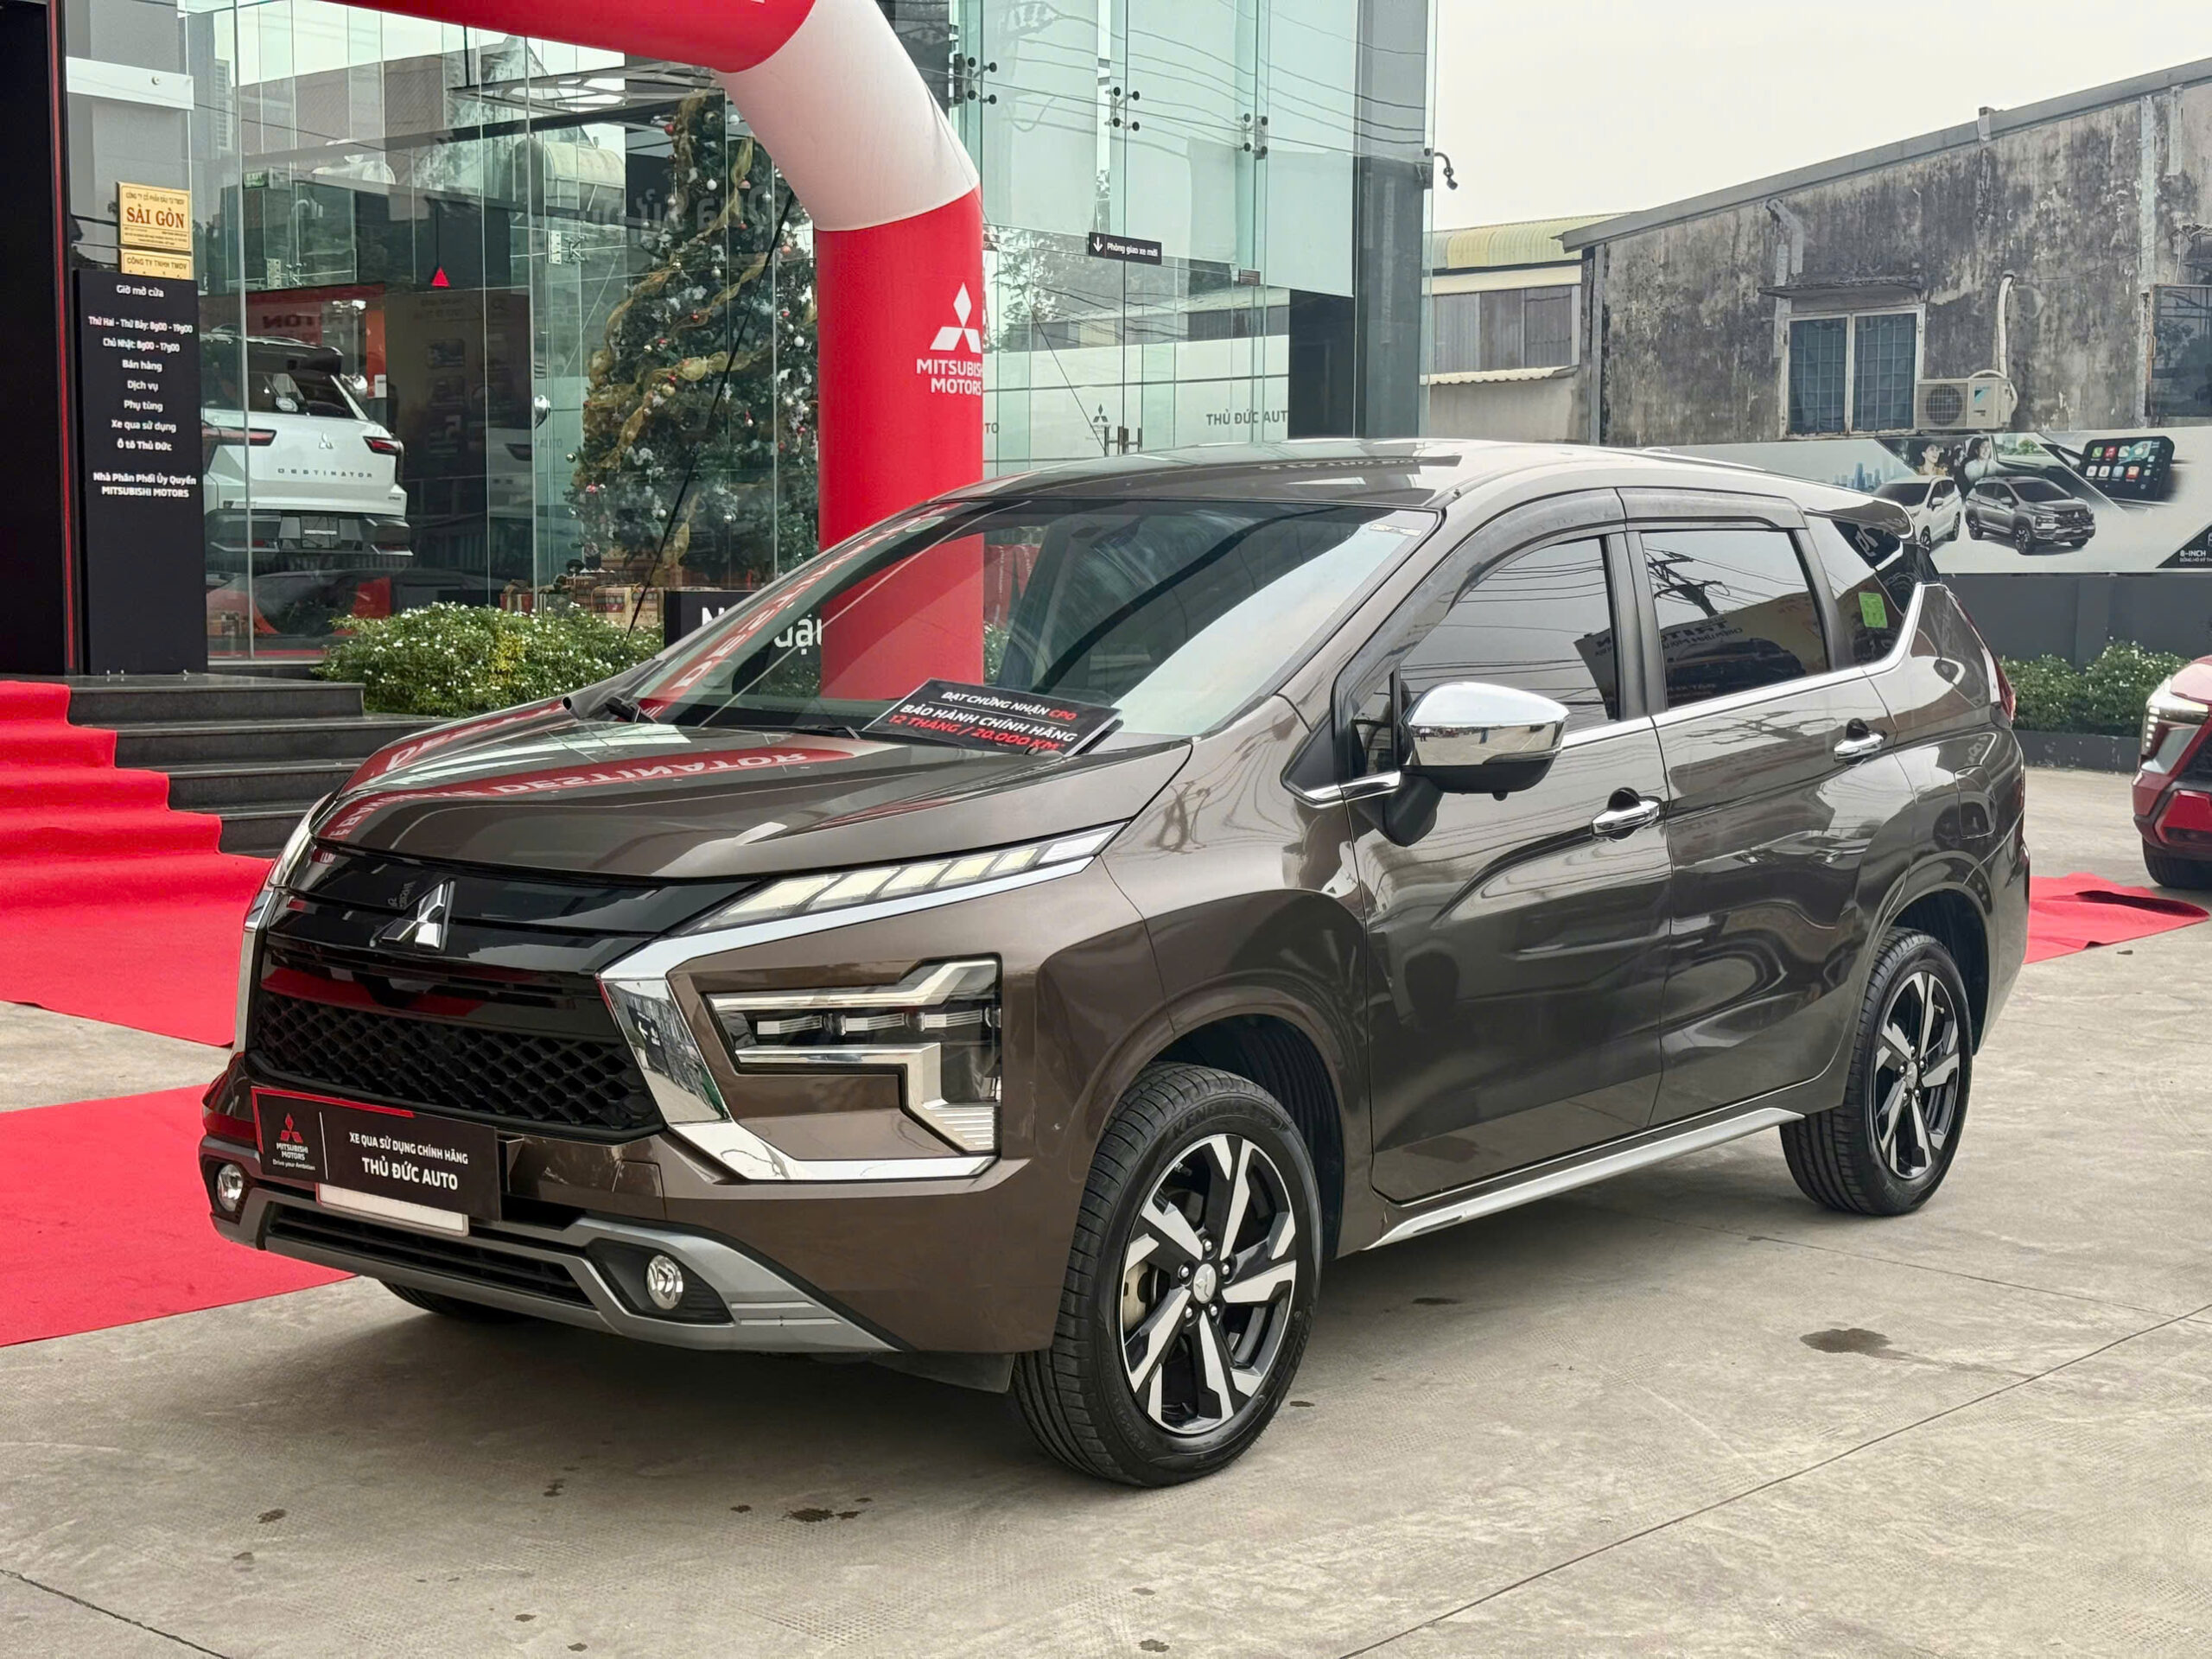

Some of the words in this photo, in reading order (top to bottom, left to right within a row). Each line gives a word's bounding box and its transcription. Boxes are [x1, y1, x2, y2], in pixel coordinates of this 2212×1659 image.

[126, 203, 151, 225] SÀI
[156, 207, 185, 229] GÒN
[116, 284, 131, 294] Giờ
[132, 286, 147, 296] mở
[148, 287, 164, 298] cửa
[103, 337, 117, 347] Chủ
[122, 359, 139, 370] Bán
[140, 360, 162, 372] hàng
[127, 380, 146, 391] Dịch
[147, 383, 159, 392] vụ
[931, 378, 982, 397] MOTORS
[124, 399, 141, 411] Phụ
[142, 401, 163, 412] tùng
[1205, 408, 1231, 426] THỦ
[1234, 408, 1259, 424] ĐỨC
[1263, 410, 1288, 423] AUT
[111, 419, 123, 429] Xe
[124, 421, 141, 431] qua
[142, 420, 153, 430] sử
[154, 422, 176, 434] dụng
[117, 437, 124, 448] Ô
[125, 440, 136, 449] tô
[137, 440, 154, 450] Thủ
[155, 442, 173, 451] Đức
[92, 472, 111, 481] Nhà
[112, 473, 135, 482] Phân
[136, 474, 156, 483] Phối
[276, 467, 373, 479] DESTINATOR
[101, 486, 152, 497] MITSUBISHI
[153, 488, 189, 498] MOTORS
[941, 690, 967, 704] ĐẠT
[965, 693, 1012, 709] CHỨNG
[1012, 702, 1049, 716] NHẬN
[1048, 709, 1077, 721] CPO
[899, 702, 933, 717] BẢO
[933, 708, 980, 724] HÀNH
[978, 714, 1029, 734] CHÍNH
[1030, 723, 1077, 743] HÃNG
[888, 714, 906, 724] 12
[906, 716, 961, 734] THÁNG
[970, 728, 1030, 746] 20.000
[276, 1142, 309, 1154] MITSUBISHI
[349, 1131, 360, 1144] XE
[361, 1134, 378, 1148] QUA
[379, 1135, 391, 1150] SỬ
[392, 1139, 416, 1155] DỤNG
[417, 1142, 442, 1160] CHÍNH
[444, 1147, 468, 1165] HÃNG
[272, 1158, 285, 1166] Drive
[281, 1150, 306, 1161] MOTORS
[361, 1154, 389, 1177] THỦ
[391, 1160, 420, 1184] ĐỨC
[422, 1168, 458, 1191] AUTO
